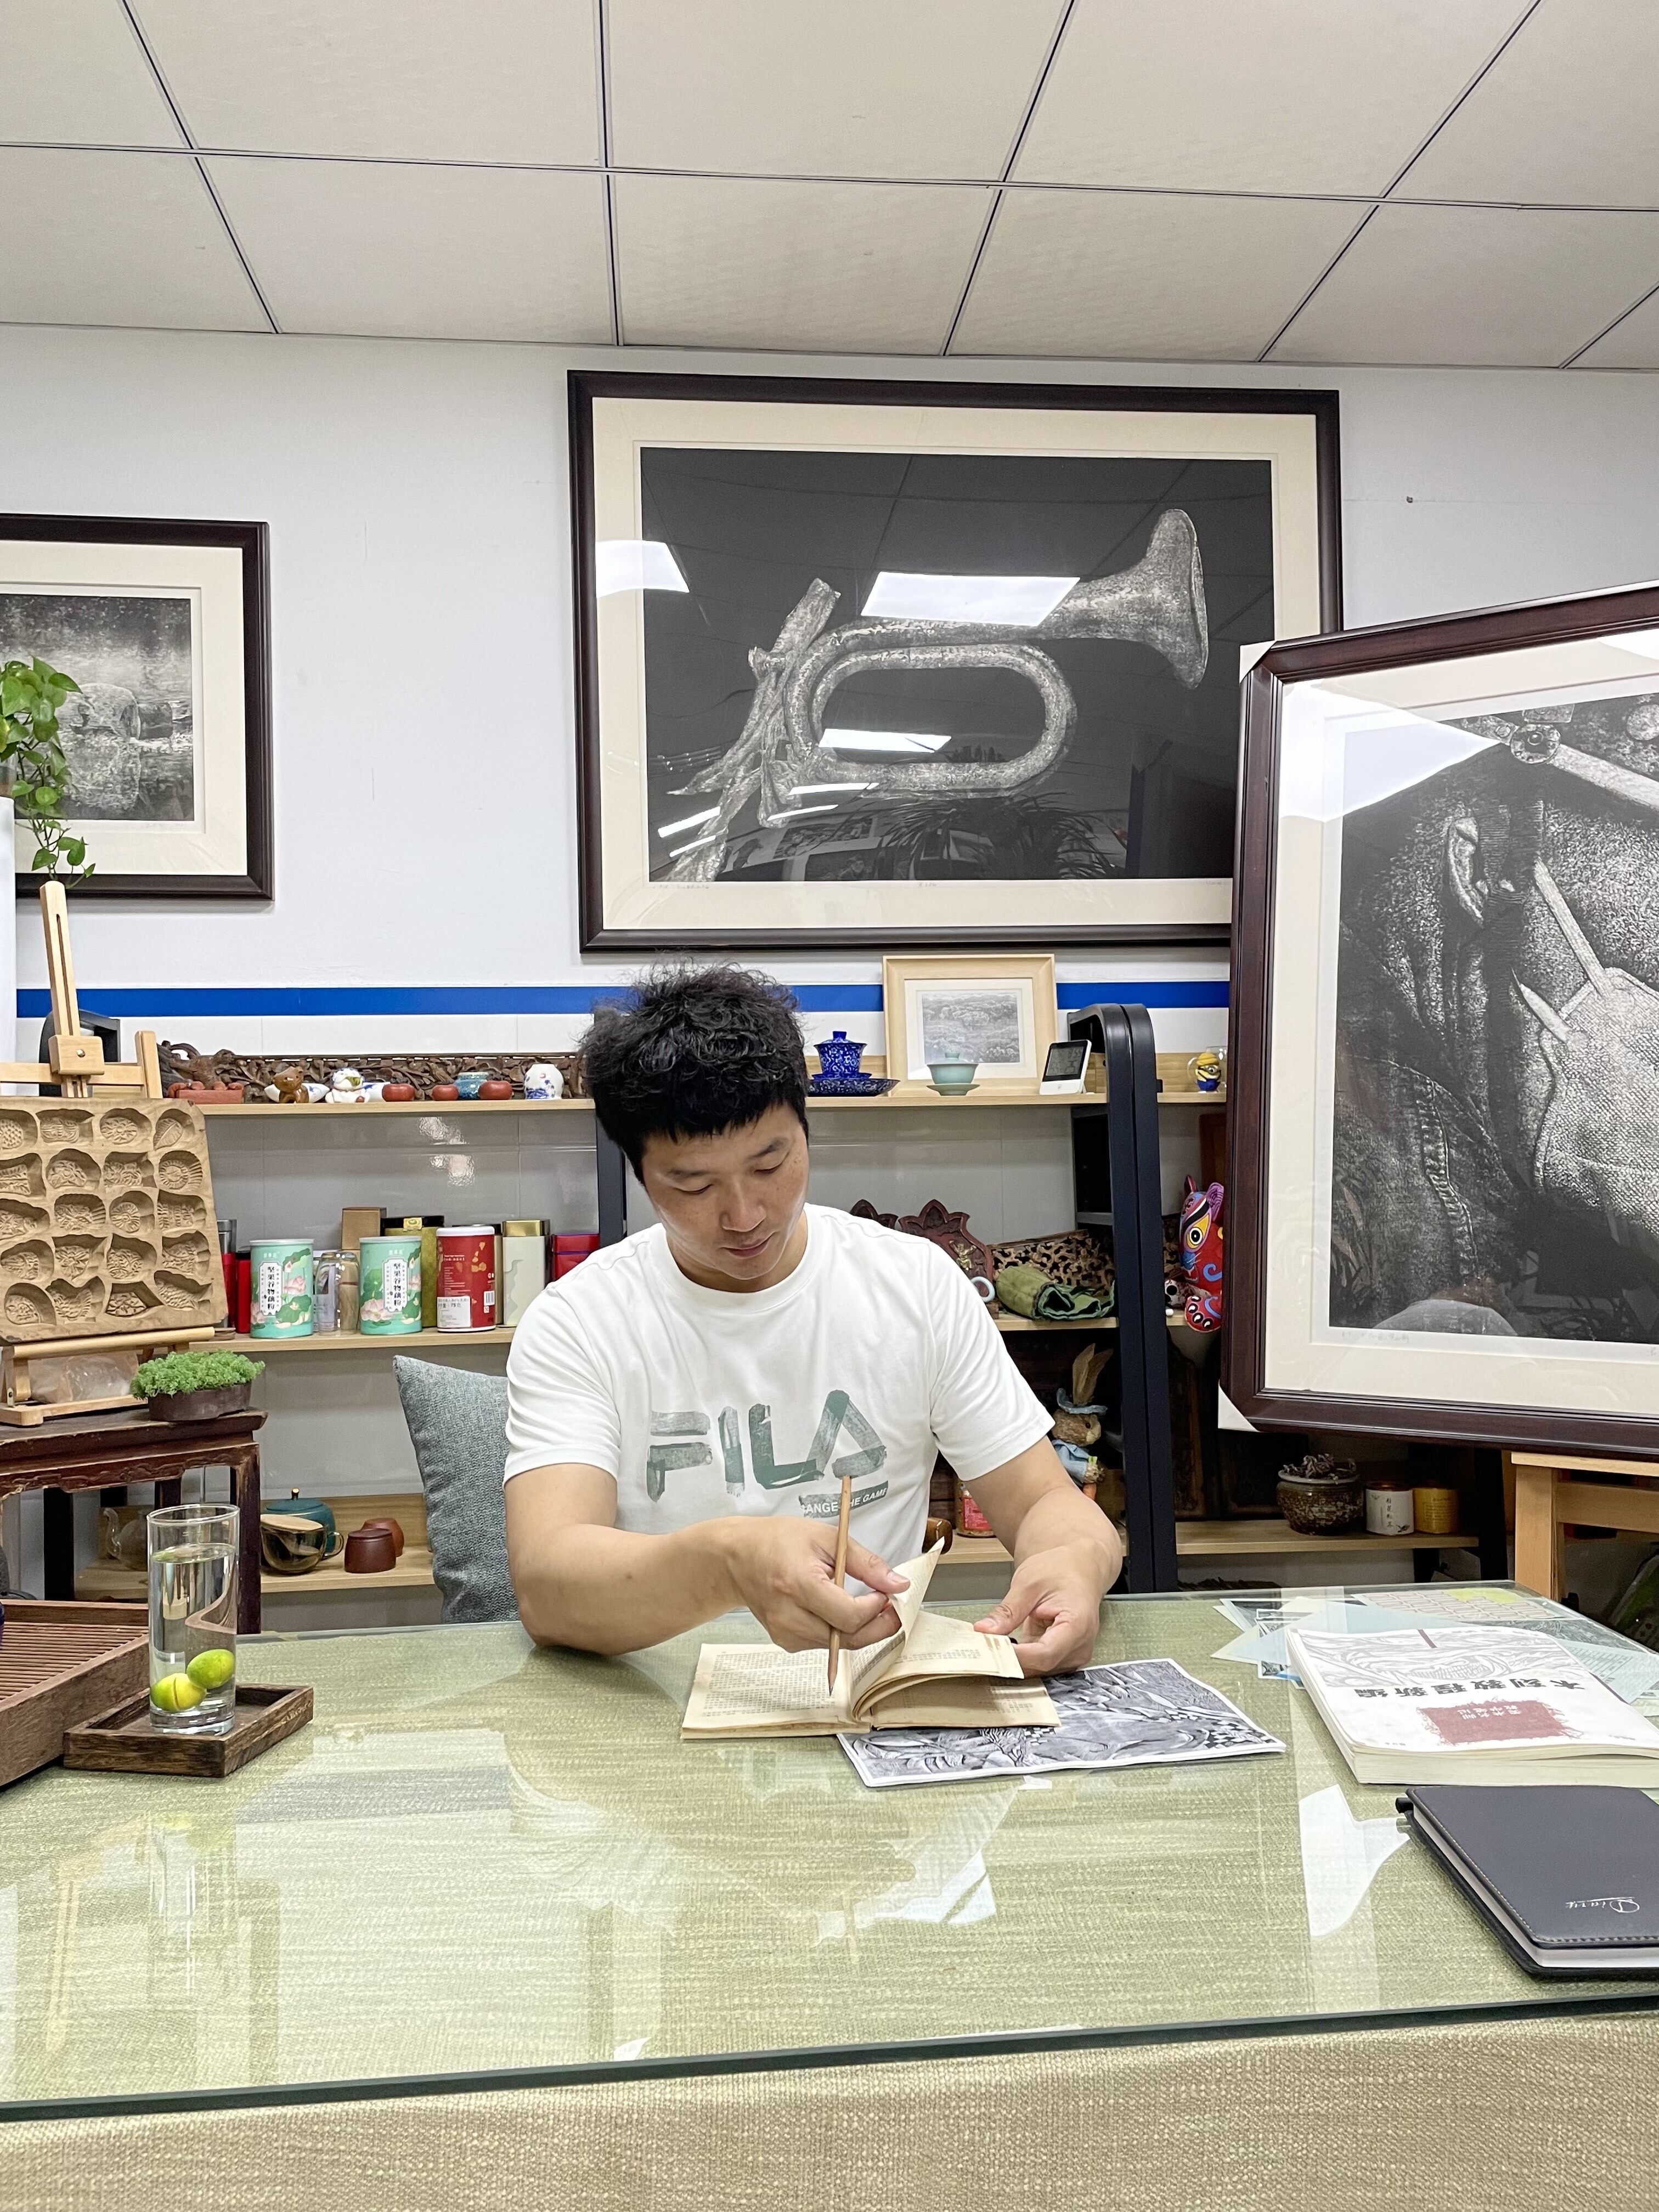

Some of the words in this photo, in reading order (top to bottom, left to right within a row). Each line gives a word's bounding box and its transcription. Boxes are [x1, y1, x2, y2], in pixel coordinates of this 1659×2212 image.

[647, 1390, 887, 1503] FILA
[850, 1497, 861, 1507] HE
[1353, 1678, 1585, 1697] 木刻教程新编
[1566, 1897, 1639, 1913] Diary
